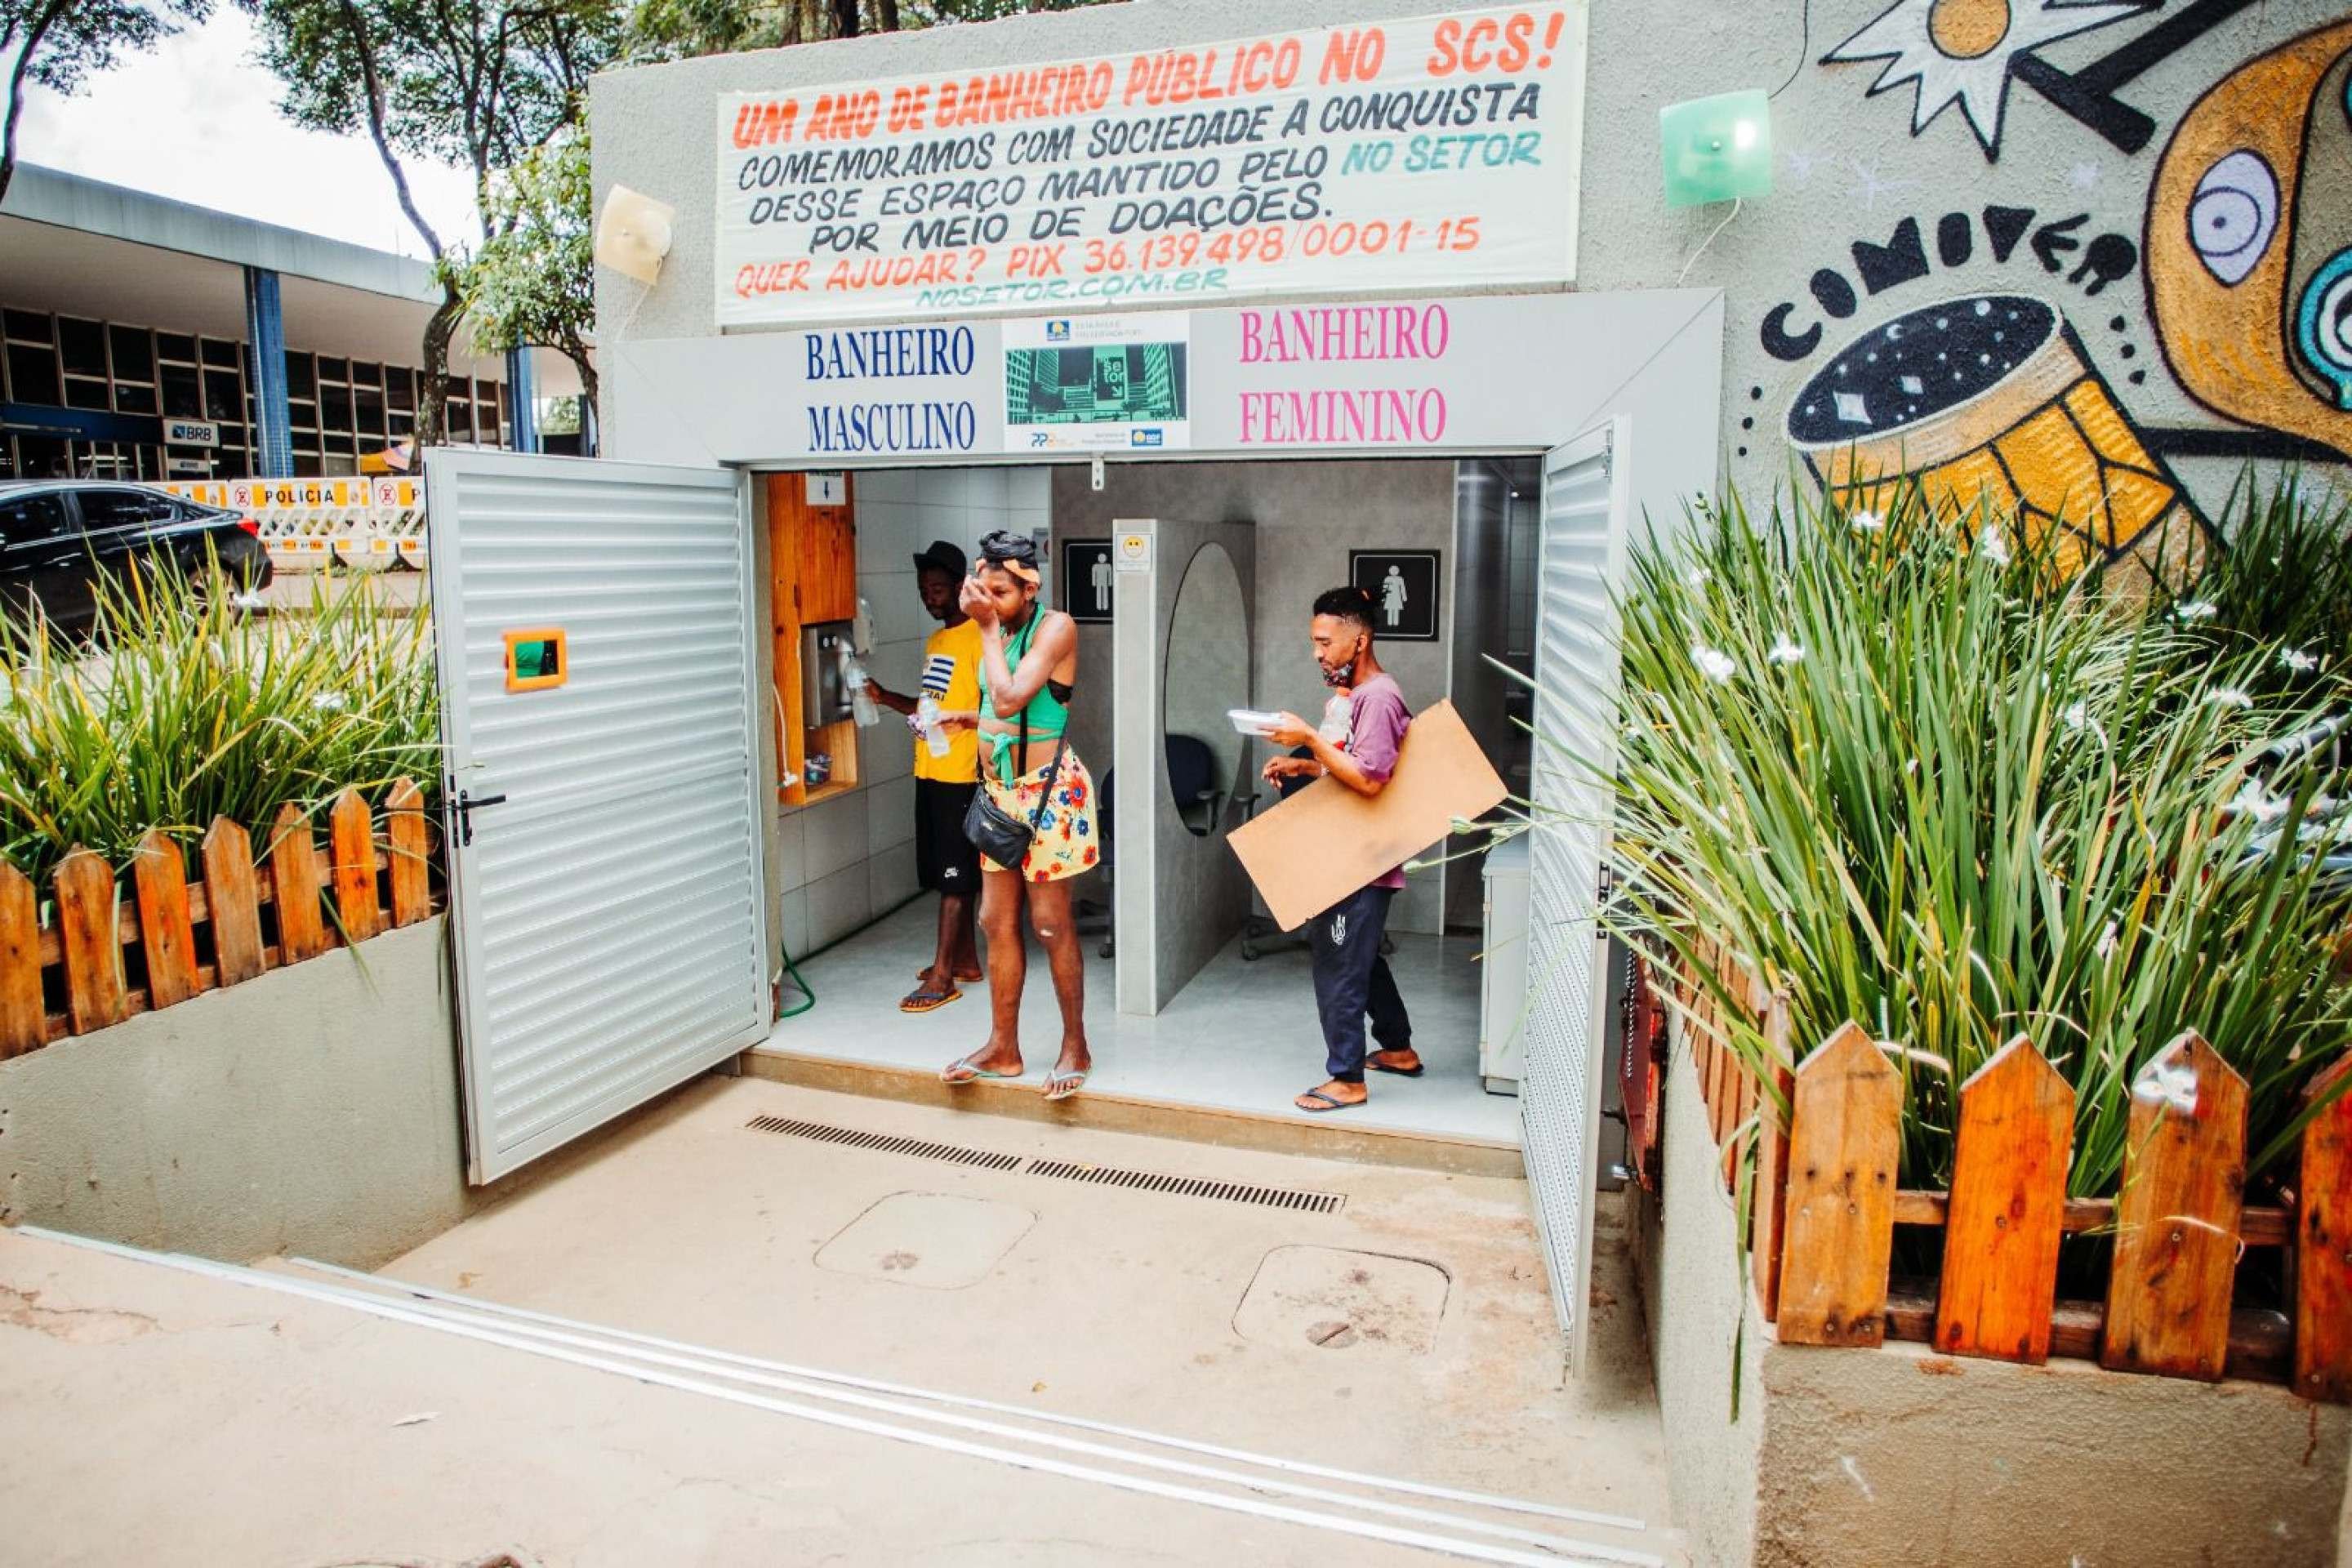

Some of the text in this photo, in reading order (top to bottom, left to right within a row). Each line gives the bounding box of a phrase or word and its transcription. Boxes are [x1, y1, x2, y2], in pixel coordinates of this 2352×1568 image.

[734, 12, 1566, 149] UM ANO DE BANHEIRO PÚBLICO NO SCS!
[739, 82, 1541, 190] COMEMORAMOS COM SOCIEDADE A CONQUISTA
[750, 131, 1542, 225] DESSE ESPAÇO MANTIDO PELO NO SETOR
[809, 181, 1332, 254] POR MEIO DE DOAÇÕES.
[736, 260, 810, 298] QUER
[826, 247, 987, 291] AJUDAR?
[1006, 243, 1065, 278] PIX
[915, 267, 1227, 308] NOSETOR.COM.BR
[804, 326, 975, 381] BANHEIRO
[1240, 304, 1450, 363] BANHEIRO
[186, 426, 211, 441] BRB
[807, 401, 976, 452] MASCULINO
[1239, 387, 1447, 443] FEMININO
